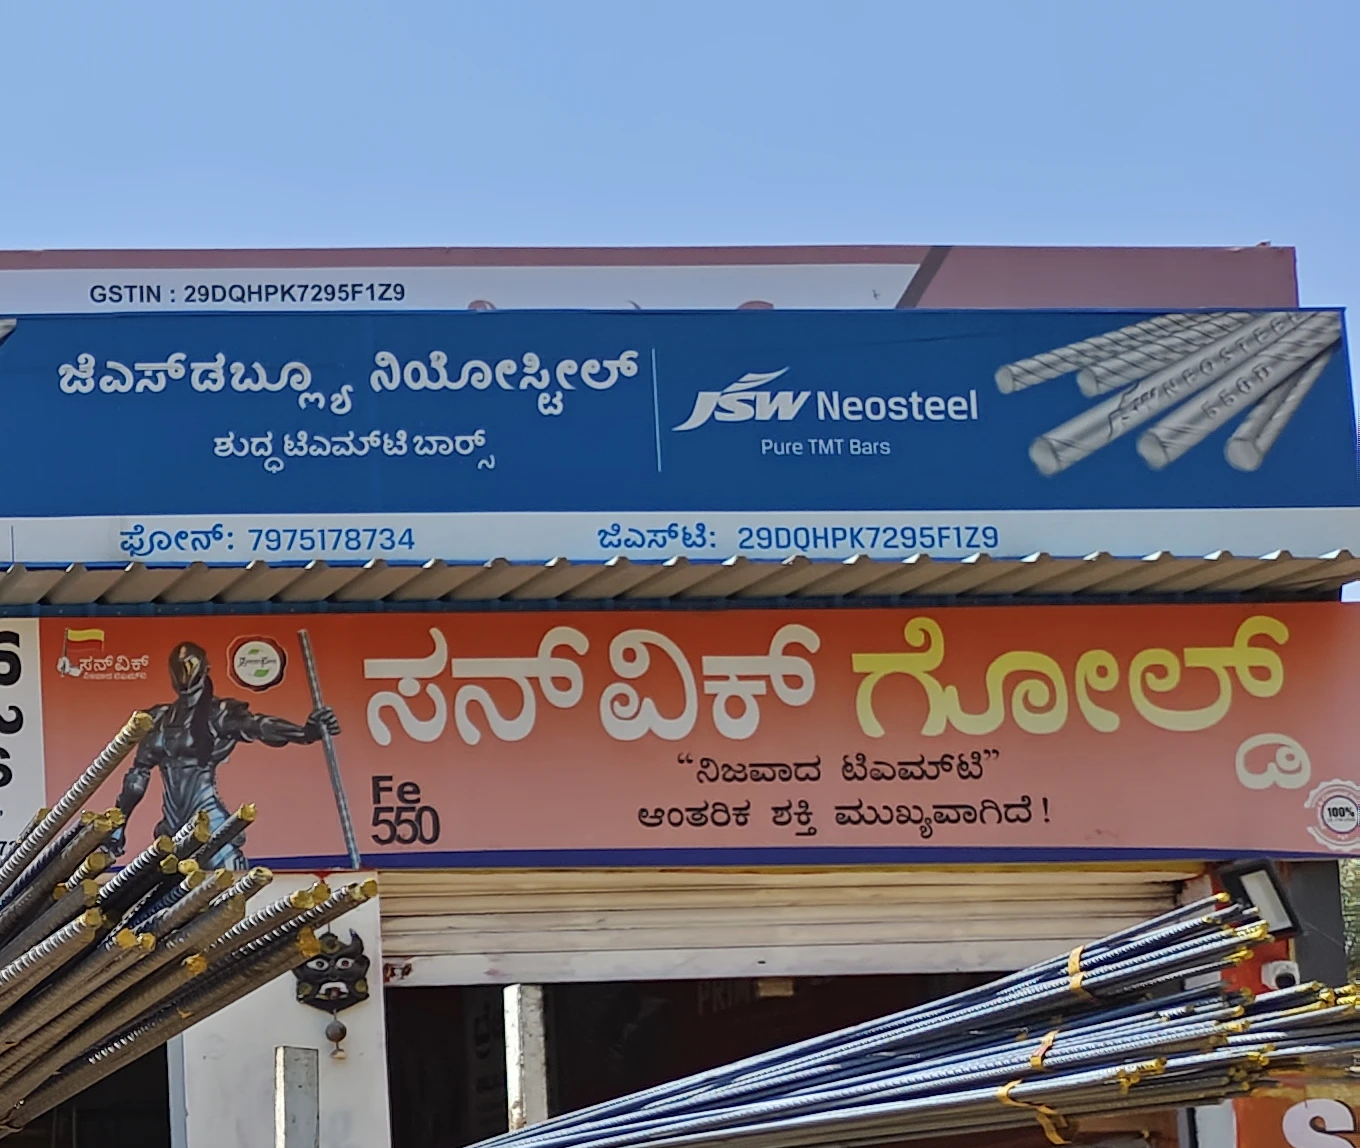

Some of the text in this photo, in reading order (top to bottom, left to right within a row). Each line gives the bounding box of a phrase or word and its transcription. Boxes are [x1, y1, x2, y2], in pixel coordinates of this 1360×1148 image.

[89, 283, 163, 306] GSTIN
[184, 281, 406, 305] 29DQHPK7295F1Z9
[672, 366, 979, 432] JSW Neosteel
[760, 437, 891, 457] Pure TMT Bars
[247, 526, 416, 553] 7975178734
[736, 524, 1000, 550] 29DQHPK7295F1Z9
[371, 775, 422, 805] Fe
[371, 805, 441, 845] 550
